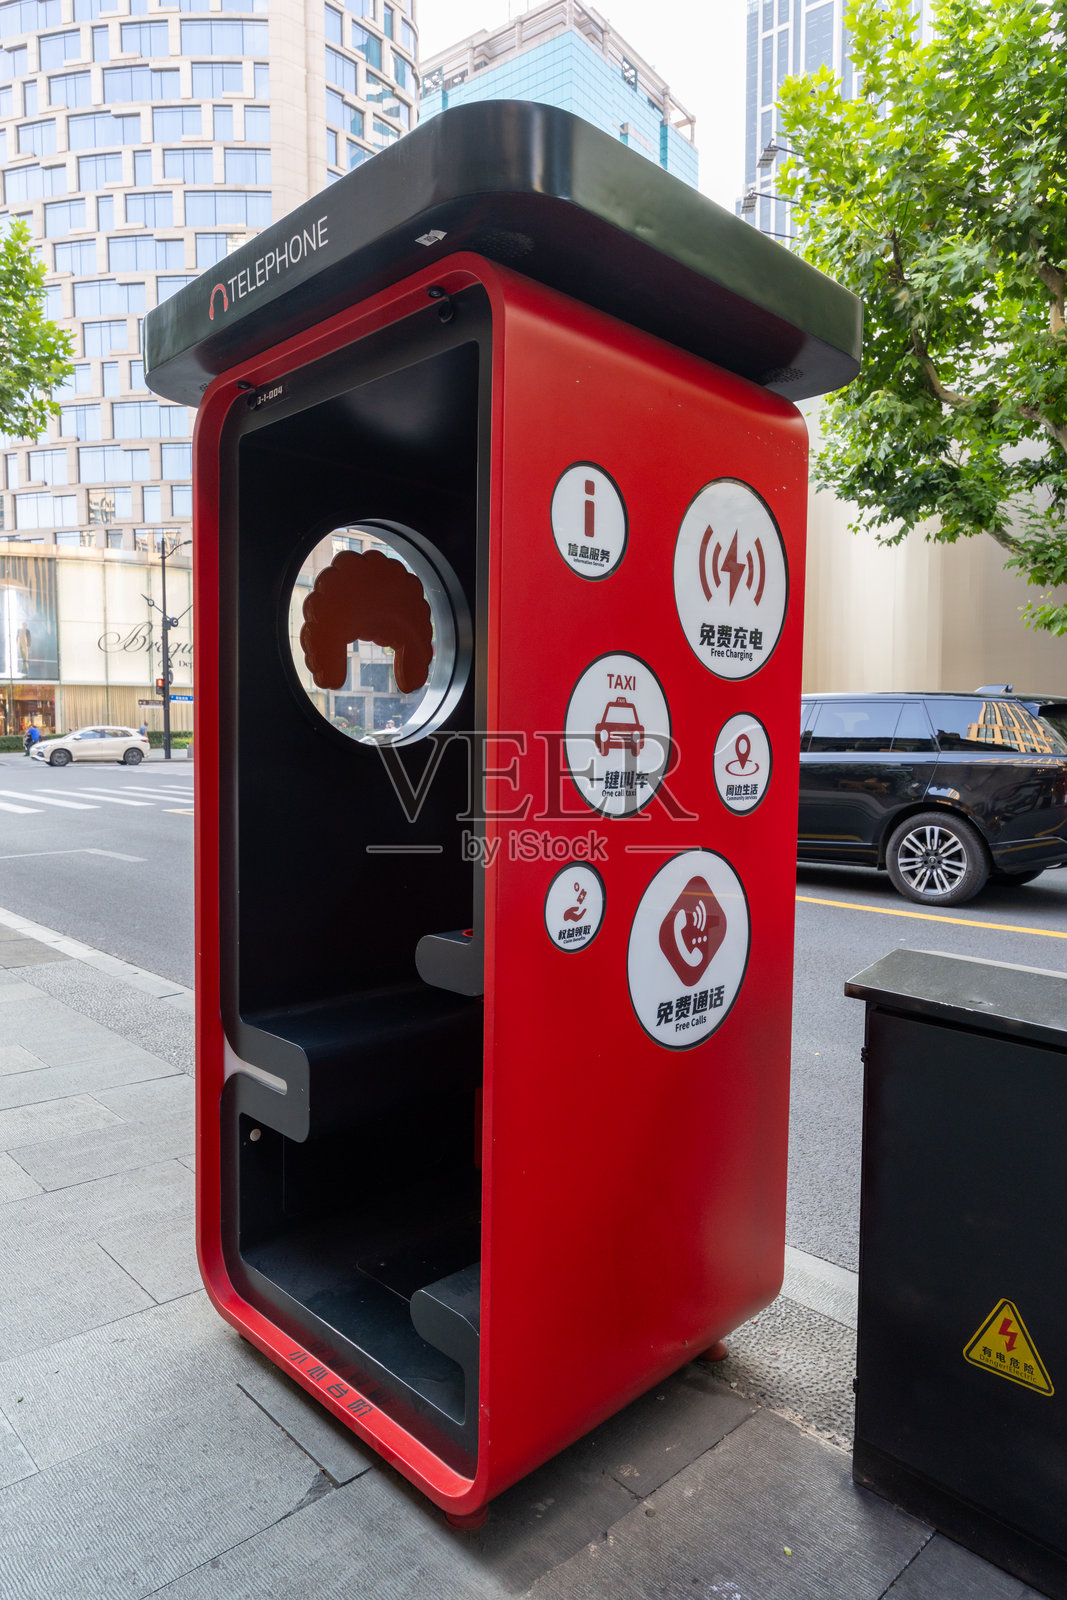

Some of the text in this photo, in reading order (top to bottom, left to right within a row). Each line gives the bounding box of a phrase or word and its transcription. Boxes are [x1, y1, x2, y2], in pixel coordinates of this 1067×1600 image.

[227, 215, 329, 302] TELEPHONE
[568, 543, 610, 563] 信息服务
[699, 622, 763, 650] 免费充电
[710, 648, 753, 661] Free Charging
[607, 673, 636, 691] TAXI
[589, 771, 649, 789] 一键叫车
[601, 788, 637, 797] One call taxi
[726, 784, 758, 796] 周边生活
[558, 925, 591, 940] 权益领取
[656, 985, 725, 1026] 免费通话
[675, 1015, 707, 1032] Free Calls
[982, 1346, 1034, 1375] 有电危险
[289, 1351, 373, 1417] 小心台阶
